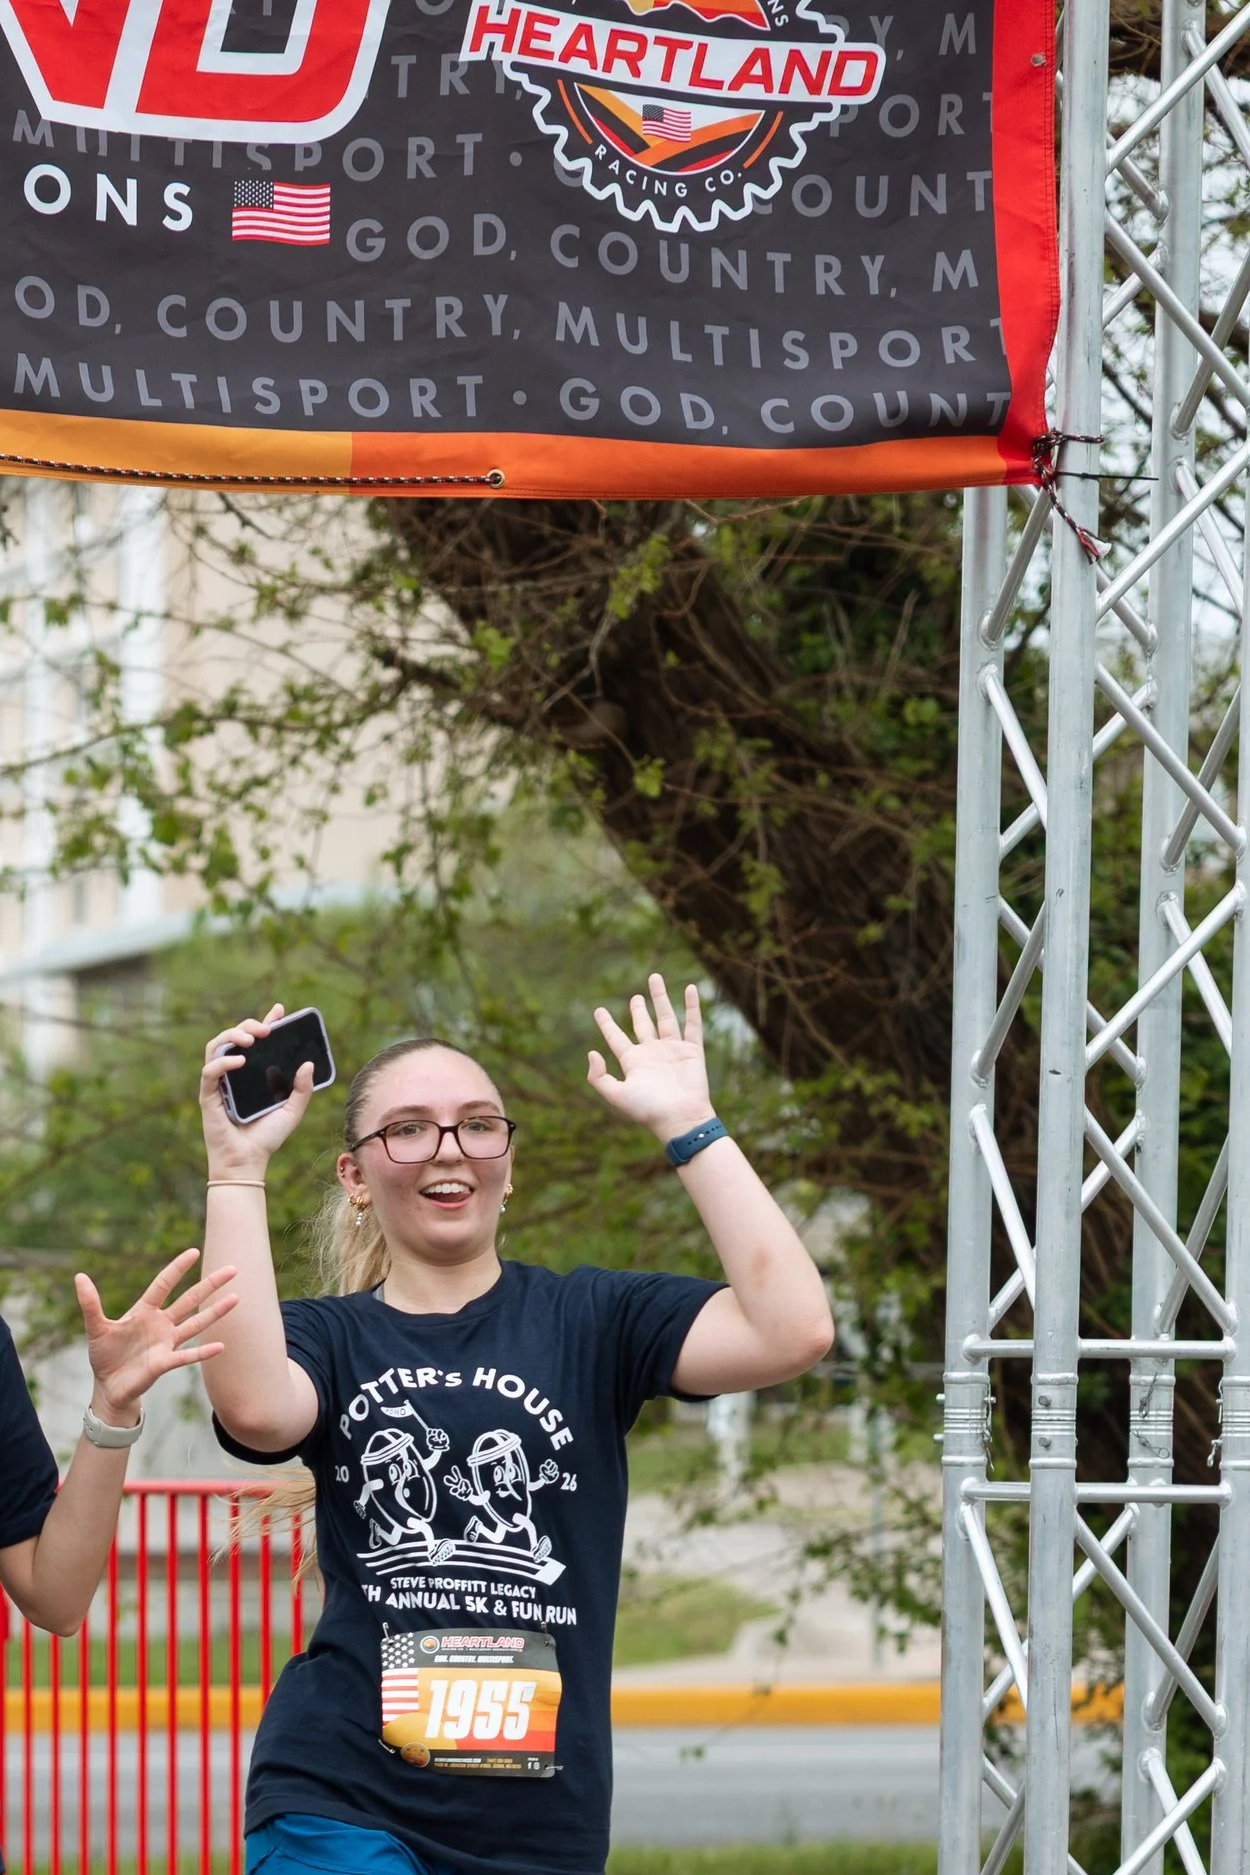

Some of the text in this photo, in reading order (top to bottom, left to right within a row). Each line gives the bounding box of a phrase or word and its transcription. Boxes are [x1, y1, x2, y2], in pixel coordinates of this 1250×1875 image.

[468, 5, 880, 98] HEARTLAND
[595, 143, 688, 197] RACING
[705, 172, 742, 192] CO.
[347, 213, 517, 262] GOD,
[550, 223, 897, 298] COUNTRY,
[157, 294, 521, 343] COUNTRY,
[13, 352, 483, 418] MULTISPORT
[559, 377, 728, 435] GOD,
[339, 1367, 574, 1451] POTTER'S HOUSE
[334, 1465, 578, 1492] 20 26
[385, 1591, 461, 1611] ANNUAL
[465, 1596, 489, 1614] 5K
[493, 1600, 507, 1616] &
[511, 1600, 543, 1622] FUN
[545, 1605, 578, 1625] RUN
[390, 1576, 537, 1600] STEVE PROFFITT LEGACY
[440, 1635, 526, 1650] HEARTLAND
[425, 1679, 538, 1741] 1955
